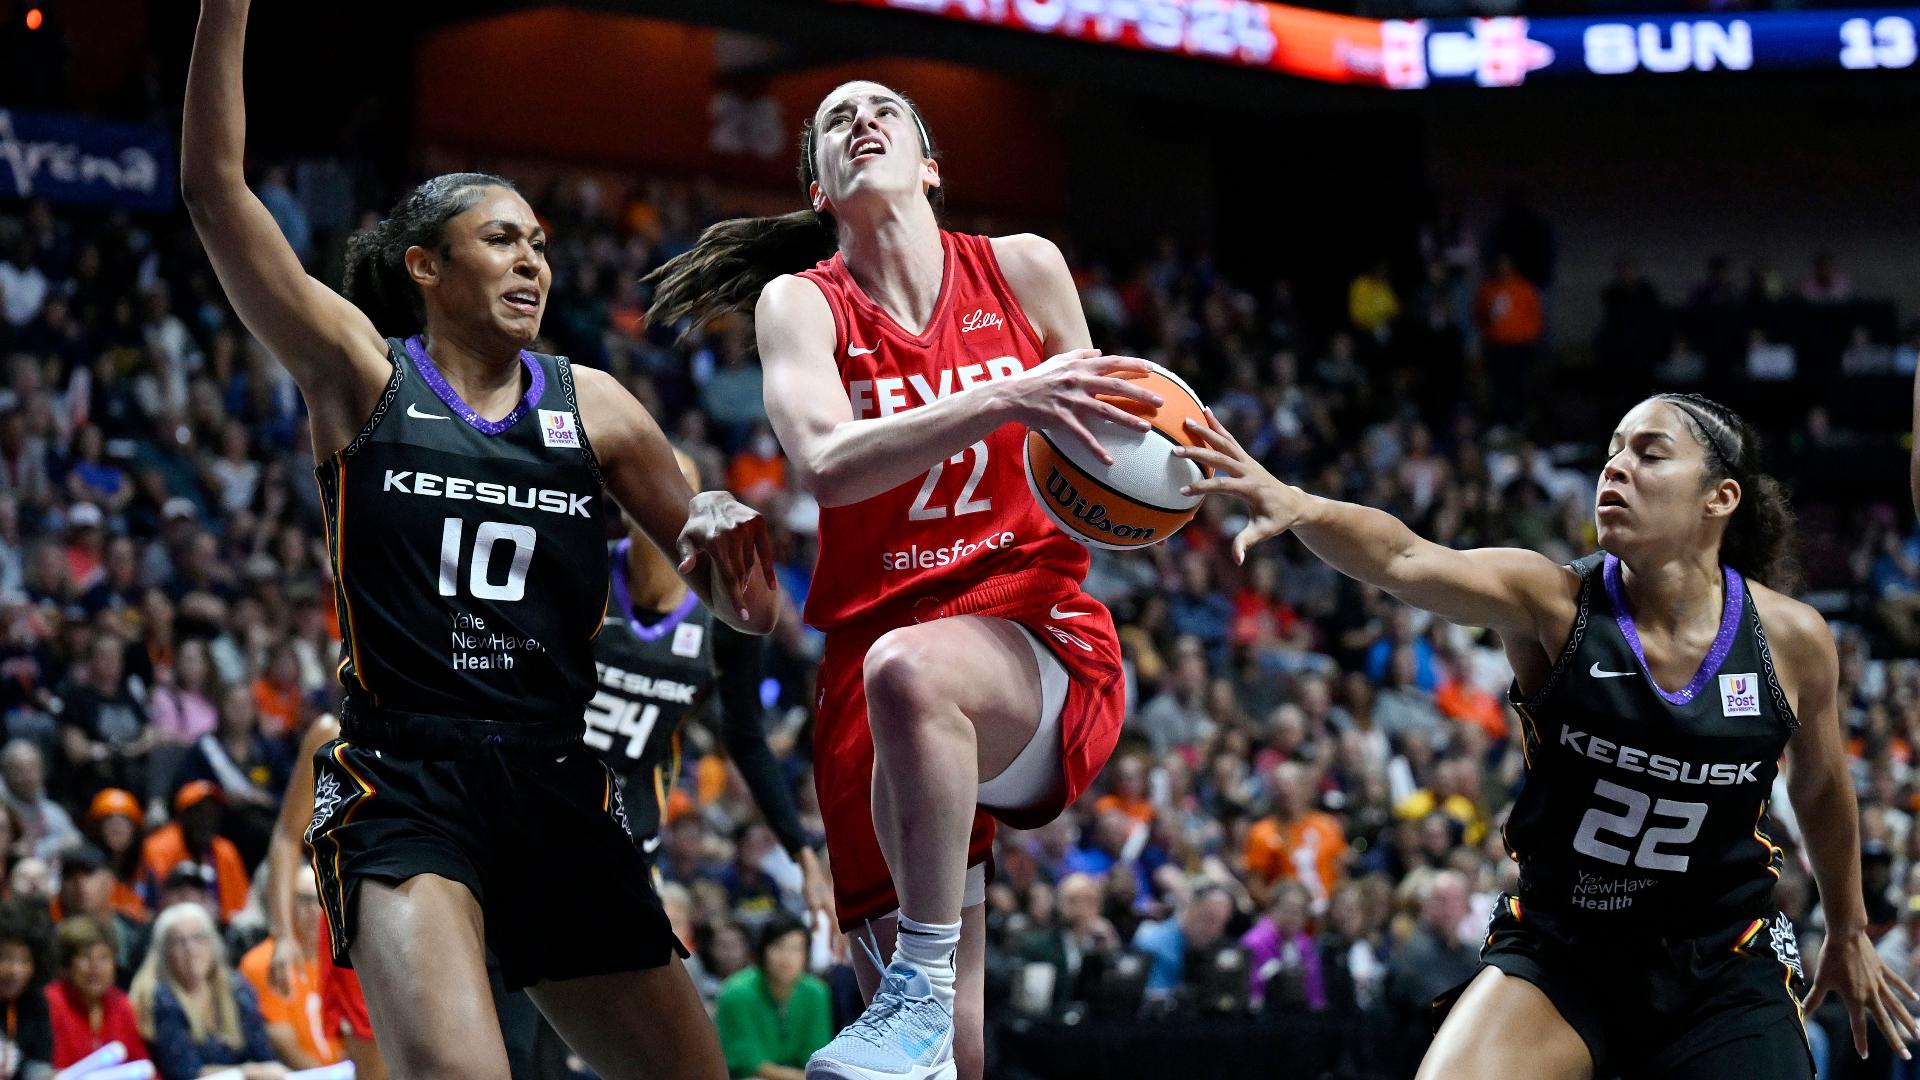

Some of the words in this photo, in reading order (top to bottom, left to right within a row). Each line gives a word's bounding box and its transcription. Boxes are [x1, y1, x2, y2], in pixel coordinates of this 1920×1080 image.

[1584, 20, 1752, 75] SUN
[962, 308, 1003, 333] Lilly
[547, 427, 574, 440] Post
[383, 469, 594, 519] KEESUSK
[908, 440, 992, 521] 22
[1046, 465, 1155, 540] Wilson
[438, 517, 537, 602] 10
[882, 530, 1015, 571] salesforce
[449, 612, 485, 630] Yale
[452, 652, 514, 670] Health
[1726, 694, 1756, 707] Post
[583, 690, 660, 759] 24
[1559, 723, 1762, 786] KEESUSK
[1572, 778, 1709, 873] 22
[1572, 895, 1633, 911] Health
[1573, 878, 1658, 894] NewHav
